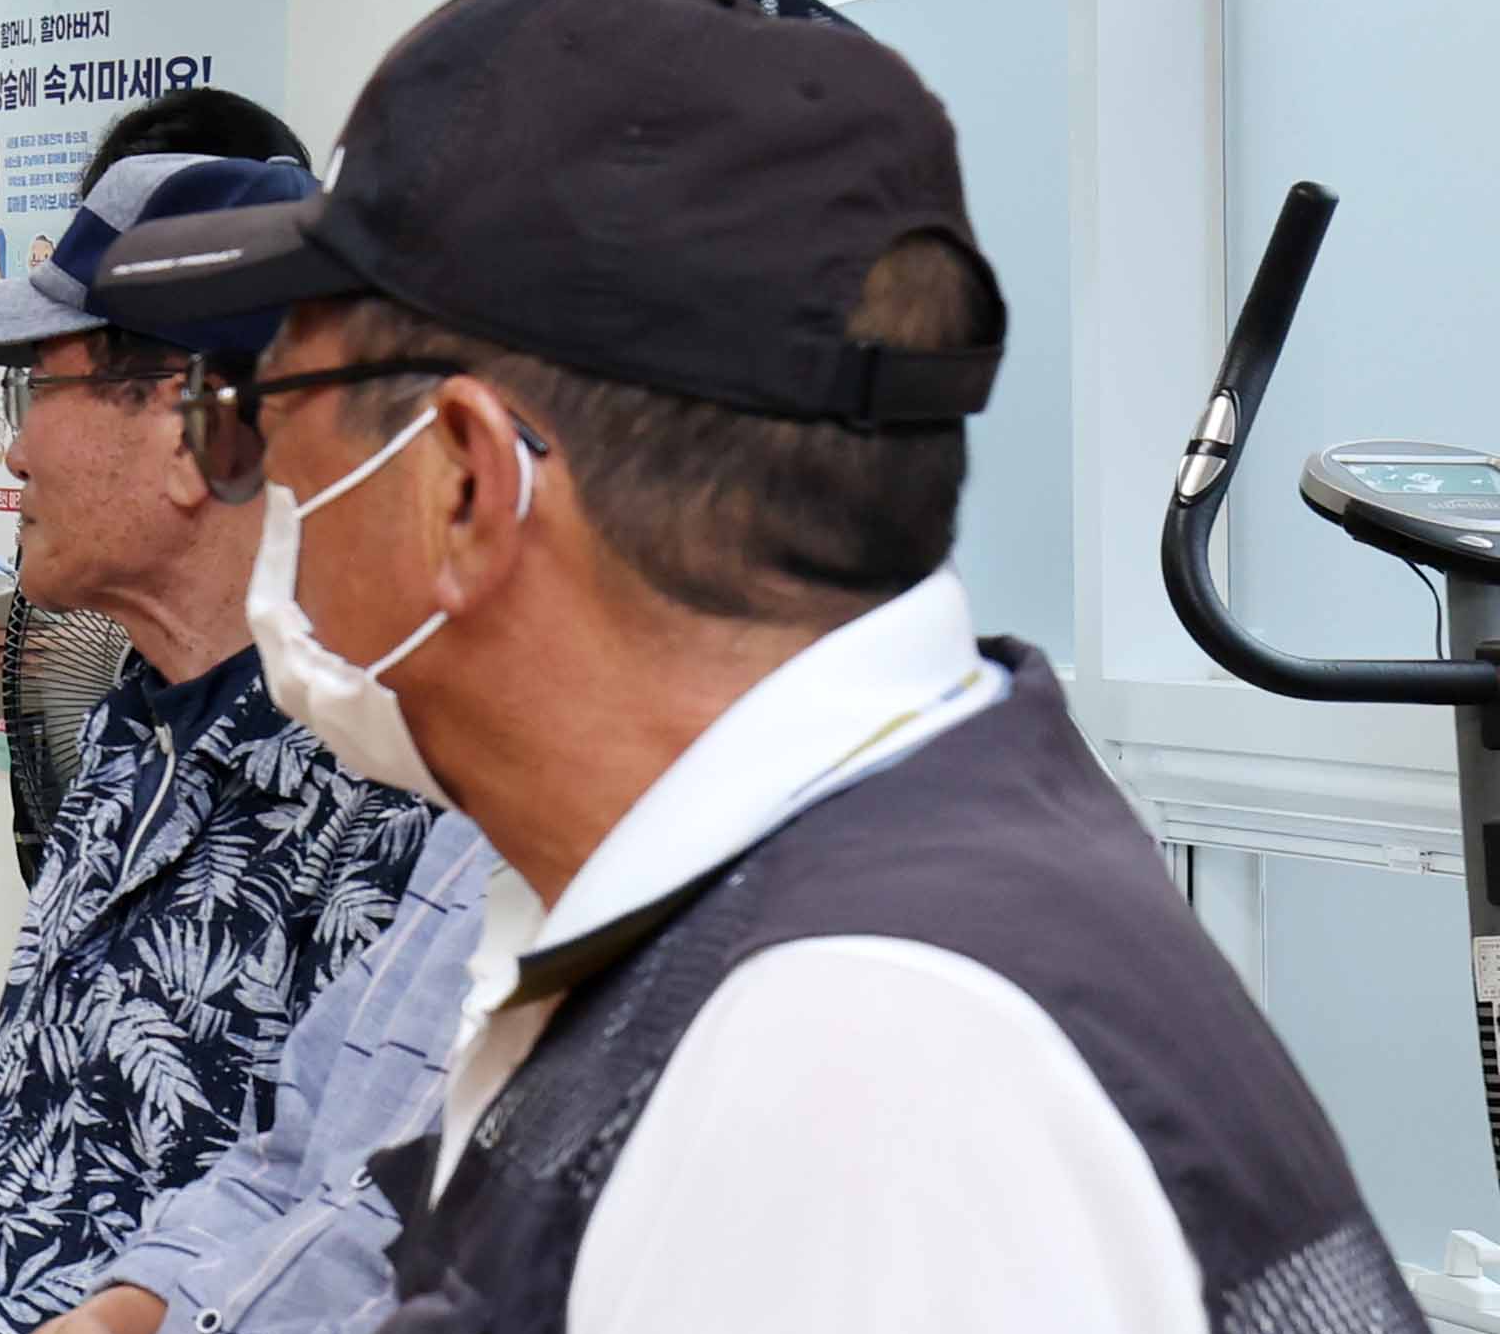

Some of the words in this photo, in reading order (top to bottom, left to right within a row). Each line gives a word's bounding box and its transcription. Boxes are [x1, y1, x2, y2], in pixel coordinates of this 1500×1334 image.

[0, 18, 36, 49] 할머니,
[40, 10, 110, 43] 할아버지
[43, 55, 213, 106] 속지마세요!
